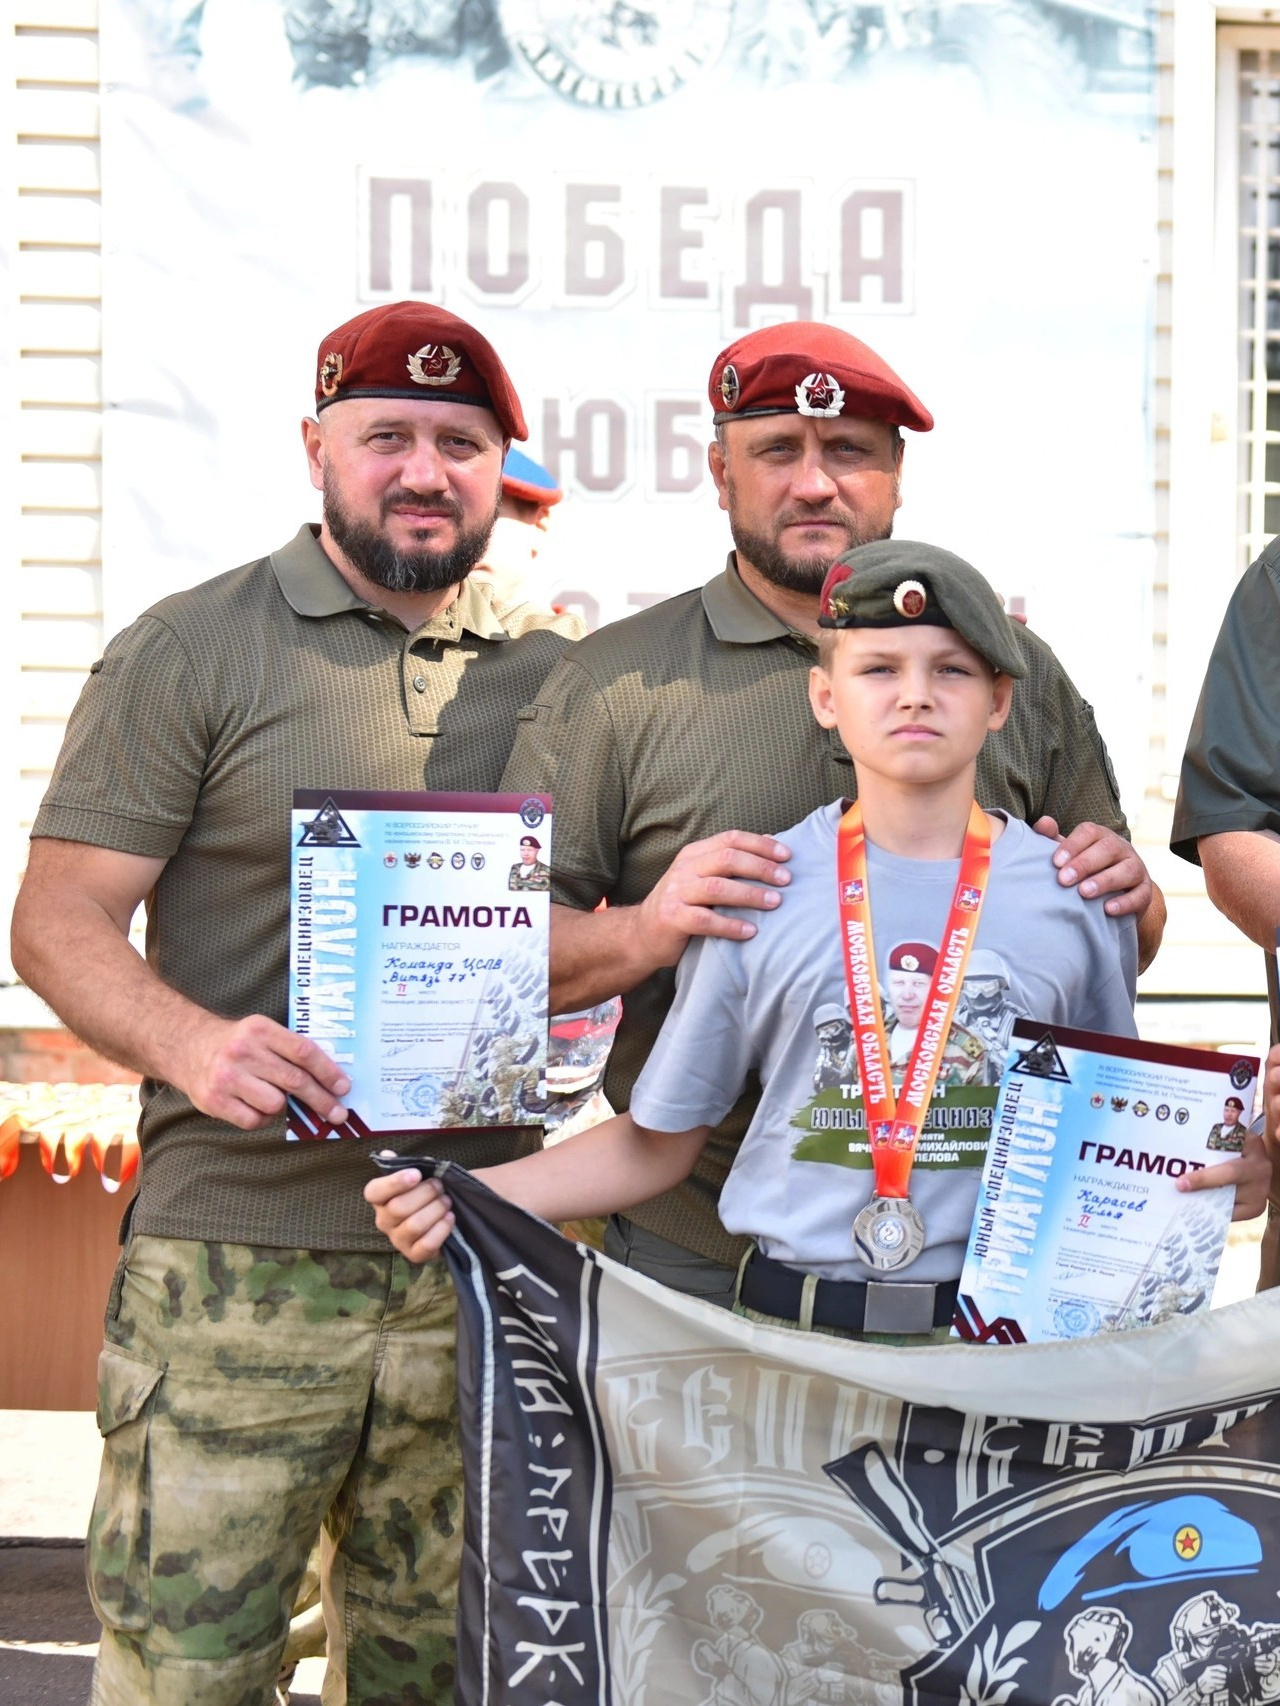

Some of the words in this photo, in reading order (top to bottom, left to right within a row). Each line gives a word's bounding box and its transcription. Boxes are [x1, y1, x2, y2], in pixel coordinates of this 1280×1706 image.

[369, 177, 904, 328] ПОБЕДА
[382, 904, 533, 928] ГРАМОТА
[381, 942, 461, 951] НАГРАЖДАЕТСЯ
[307, 869, 358, 1065] РИАТЛОН
[384, 957, 454, 975] Команда
[296, 996, 310, 1034] НЫЙ
[905, 999, 949, 1107] МОСКОВСКАЯ
[937, 926, 969, 994] ОБЛАСТЬ
[811, 1106, 868, 1130] ЮНЫ
[1078, 1140, 1206, 1179] ГРАМОТ
[977, 1094, 1064, 1295] ТРИАТЛОН
[1073, 1174, 1150, 1194] НАГРАЖДАЕТСЯ
[1077, 1188, 1148, 1213] Карасев
[974, 1207, 997, 1258] ЮНЫЙ
